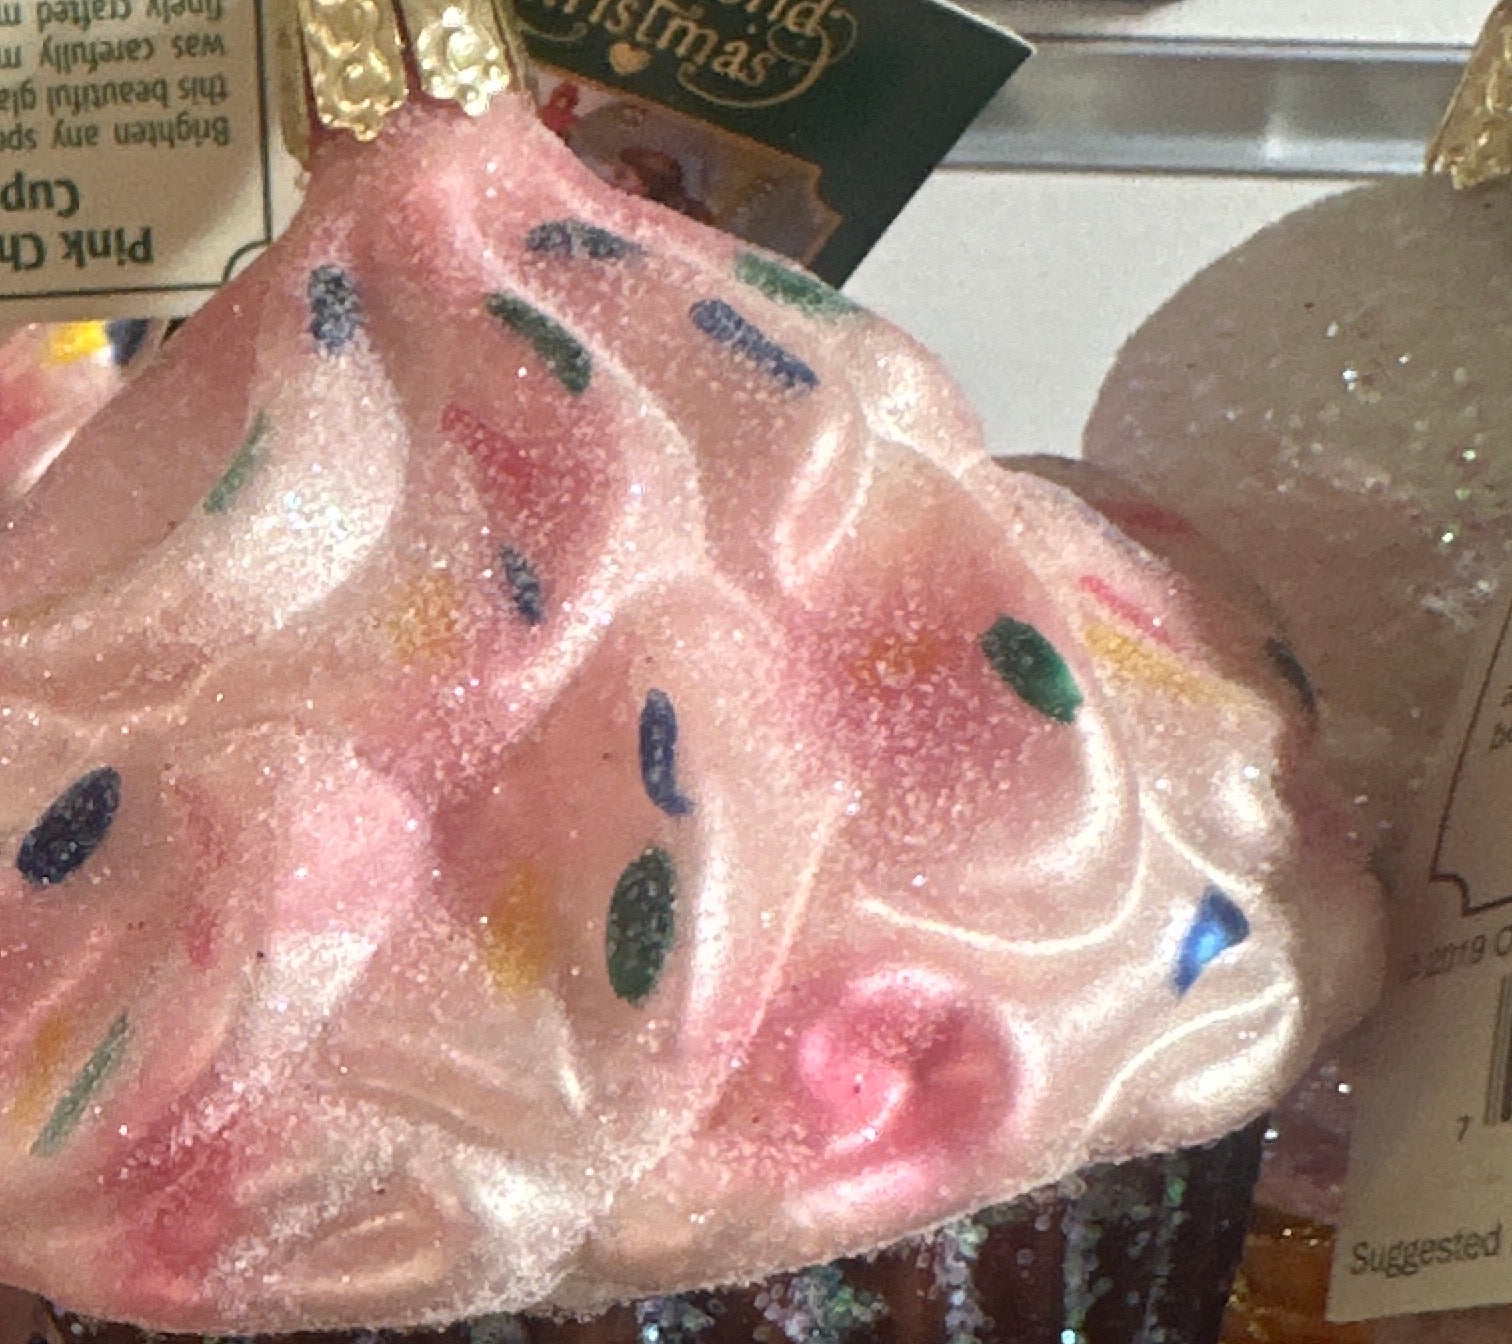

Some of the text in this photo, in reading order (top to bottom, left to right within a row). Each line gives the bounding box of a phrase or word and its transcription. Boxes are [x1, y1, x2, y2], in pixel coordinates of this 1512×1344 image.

[39, 34, 155, 75] carefully
[170, 33, 226, 58] was
[46, 75, 170, 117] beautiful
[177, 71, 229, 106] this
[51, 118, 102, 150] any
[113, 111, 231, 150] Brighten
[59, 225, 155, 269] Pink
[1349, 1221, 1504, 1279] Suggested
